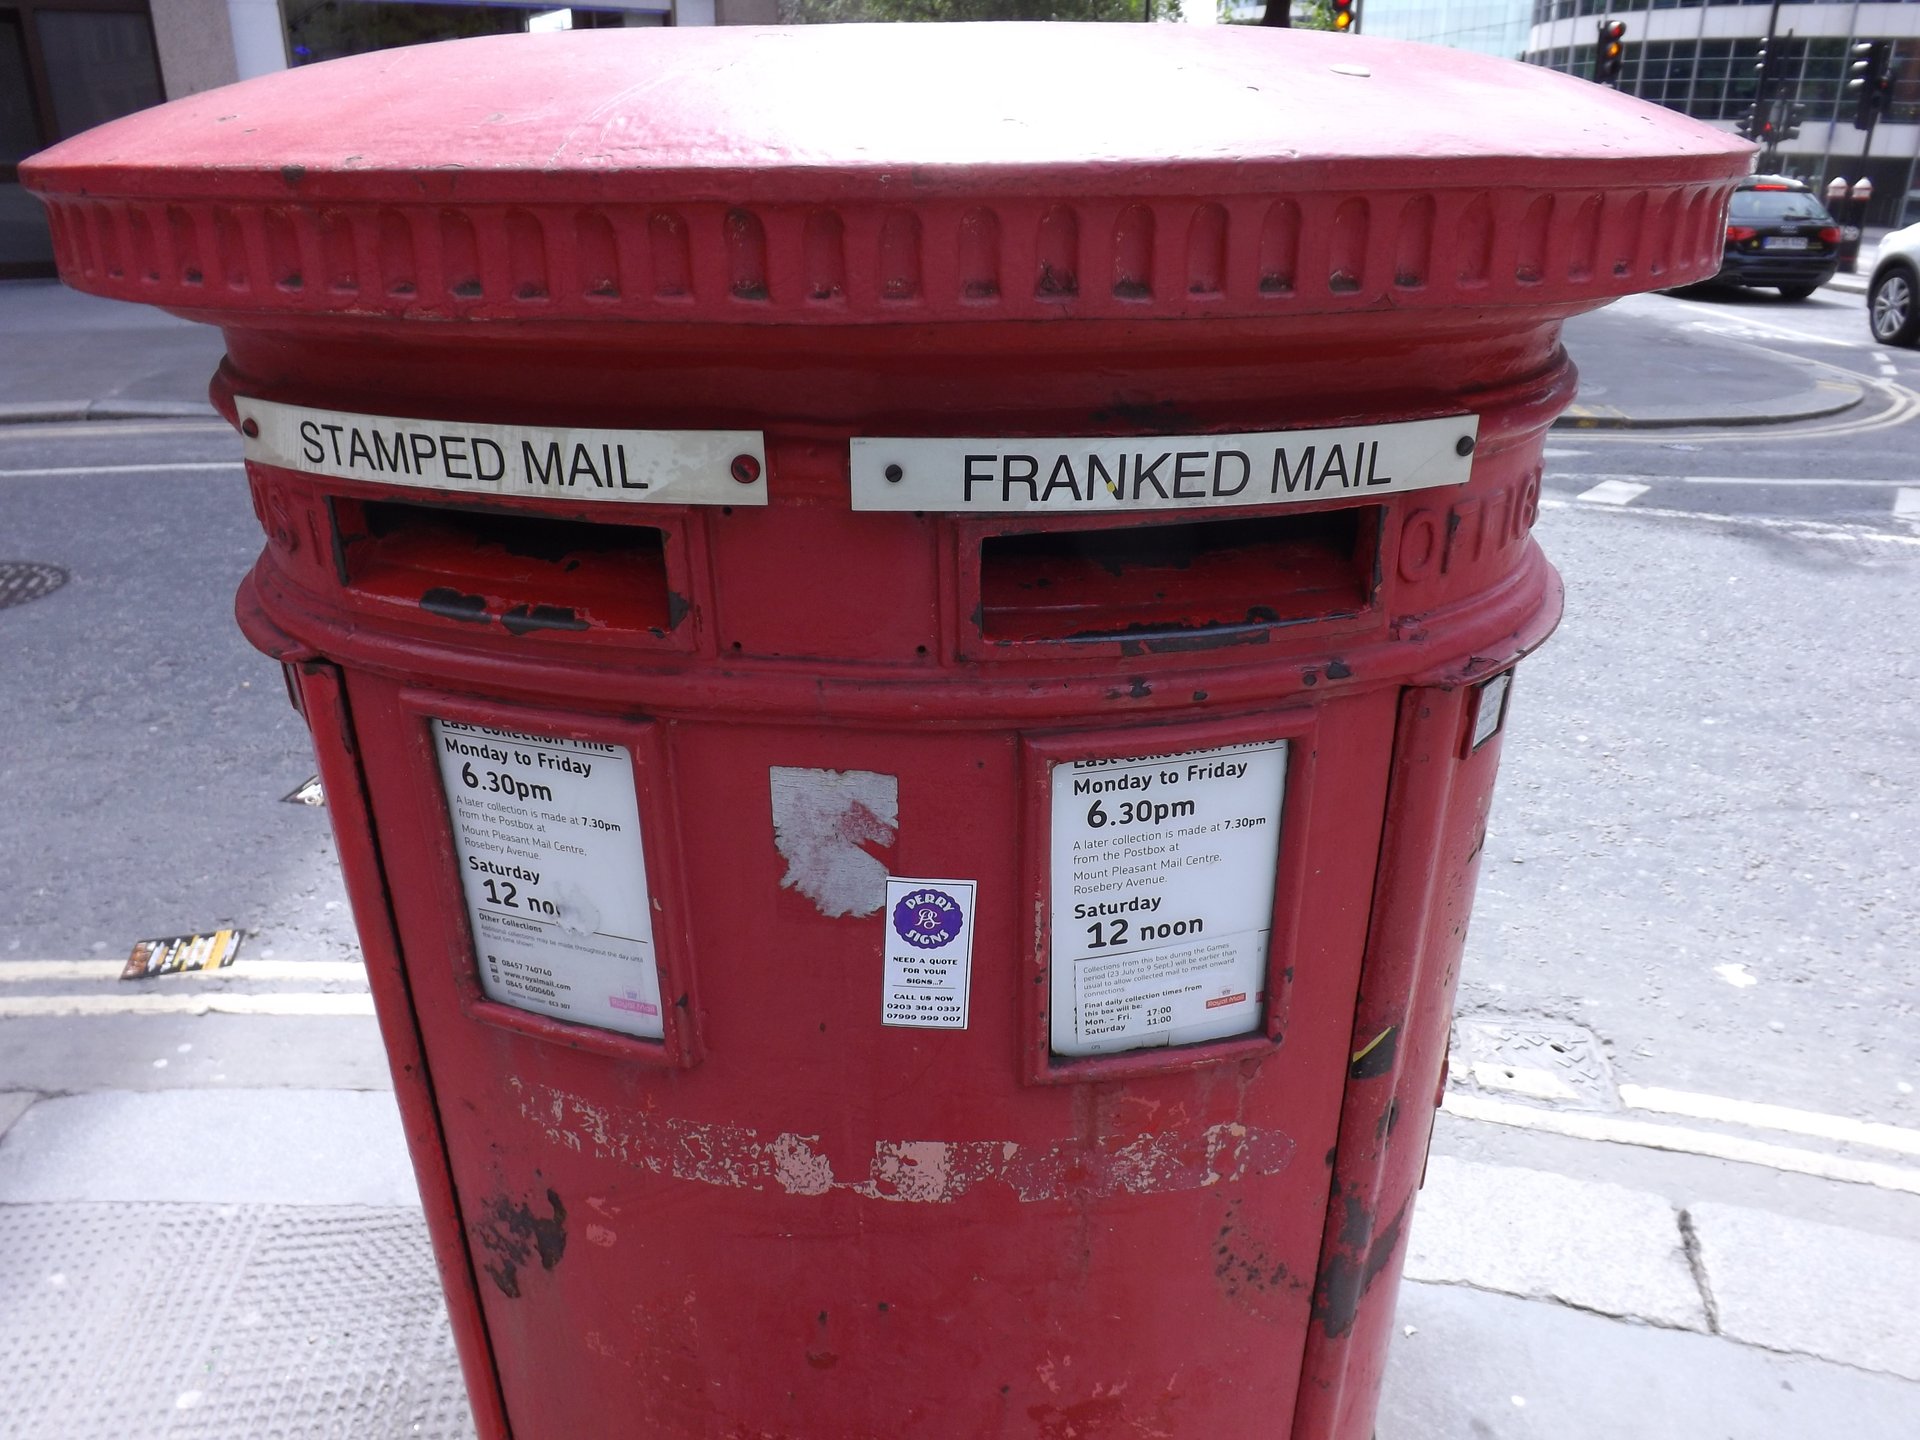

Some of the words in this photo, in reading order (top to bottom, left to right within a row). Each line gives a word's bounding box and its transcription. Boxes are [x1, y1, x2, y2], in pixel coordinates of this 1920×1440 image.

[300, 421, 506, 480] STAMPED
[521, 440, 648, 489] MAIL
[964, 451, 1250, 501] FRANKED
[1271, 441, 1392, 494] MAIL
[445, 737, 508, 765] Monday
[514, 750, 532, 766] to
[538, 752, 592, 778] Friday
[462, 762, 553, 802] 6.30pm
[1074, 774, 1152, 796] Monday
[1160, 770, 1179, 786] to
[1188, 762, 1248, 782] Friday
[456, 794, 462, 804] A
[464, 796, 484, 808] later
[487, 802, 528, 816] collection
[530, 810, 538, 818] is
[541, 812, 566, 823] made
[570, 817, 580, 826] at
[582, 816, 621, 832] 7.30pm
[458, 808, 480, 820] from
[482, 813, 496, 824] the
[499, 816, 534, 830] Postbox
[537, 824, 546, 832] at
[1087, 800, 1196, 828] 6.30pm
[462, 824, 490, 838] Mount
[492, 830, 530, 845] Pleasant
[532, 837, 552, 849] Mail
[465, 837, 504, 854] Rosebery
[1073, 841, 1081, 851] A
[1084, 840, 1108, 850] later
[1112, 832, 1162, 846] collection
[1165, 829, 1174, 839] is
[1178, 824, 1207, 838] made
[1210, 824, 1220, 832] at
[1224, 817, 1266, 830] 7.30pm
[1073, 854, 1099, 864] from
[1103, 851, 1120, 861] the
[1124, 845, 1166, 858] Postbox
[1168, 842, 1180, 852] at
[468, 856, 540, 886] Saturday
[1073, 869, 1108, 882] Mount
[1112, 862, 1156, 876] Pleasant
[1160, 857, 1182, 870] Mail
[483, 878, 520, 908] 12
[1074, 882, 1123, 895] Rosebery
[1126, 875, 1168, 888] Avenue.
[904, 893, 955, 912] PERRY
[1074, 896, 1162, 920] Saturday
[479, 912, 500, 924] Other
[502, 918, 542, 933] Collections
[1086, 919, 1128, 949] 12
[1140, 918, 1204, 942] noon
[904, 928, 950, 945] SIGNS
[608, 950, 617, 958] the
[619, 952, 629, 960] day
[892, 956, 916, 964] NEED
[930, 958, 958, 966] QUOTE
[1084, 963, 1120, 974] Collections
[1122, 960, 1140, 968] from
[1141, 957, 1154, 965] this
[1156, 954, 1168, 962] box
[1170, 950, 1192, 960] during
[1194, 946, 1204, 954] the
[1206, 942, 1230, 952] Games
[502, 960, 522, 970] 08457
[525, 964, 552, 976] 740740
[504, 970, 571, 990] www.royalmail.com
[1084, 973, 1106, 983] period
[1108, 970, 1120, 978] (23
[1122, 968, 1136, 976] July
[1199, 953, 1220, 962] earlier
[1084, 981, 1103, 990] usual
[1114, 977, 1132, 986] allow
[1134, 972, 1164, 982] collected
[1190, 964, 1208, 972] meet
[1210, 958, 1235, 968] onward
[506, 979, 522, 989] 0845
[524, 984, 556, 998] 6000606
[906, 978, 944, 986] SIGNS...?
[1084, 999, 1103, 1009] Final
[1106, 998, 1122, 1006] daily
[1125, 992, 1160, 1003] collection
[1162, 988, 1182, 996] times
[1184, 984, 1202, 992] from
[1206, 998, 1227, 1008] Royal
[886, 1012, 917, 1020] 07999
[1084, 1010, 1098, 1018] this
[1101, 1007, 1114, 1015] box
[1116, 1004, 1130, 1012] will
[1132, 1002, 1143, 1010] be:
[1085, 1018, 1107, 1026] Mon.
[1117, 1012, 1132, 1022] Fri.
[1146, 1006, 1172, 1016] 17:00
[1085, 1024, 1126, 1036] Saturday
[1146, 1016, 1172, 1026] 11:00
